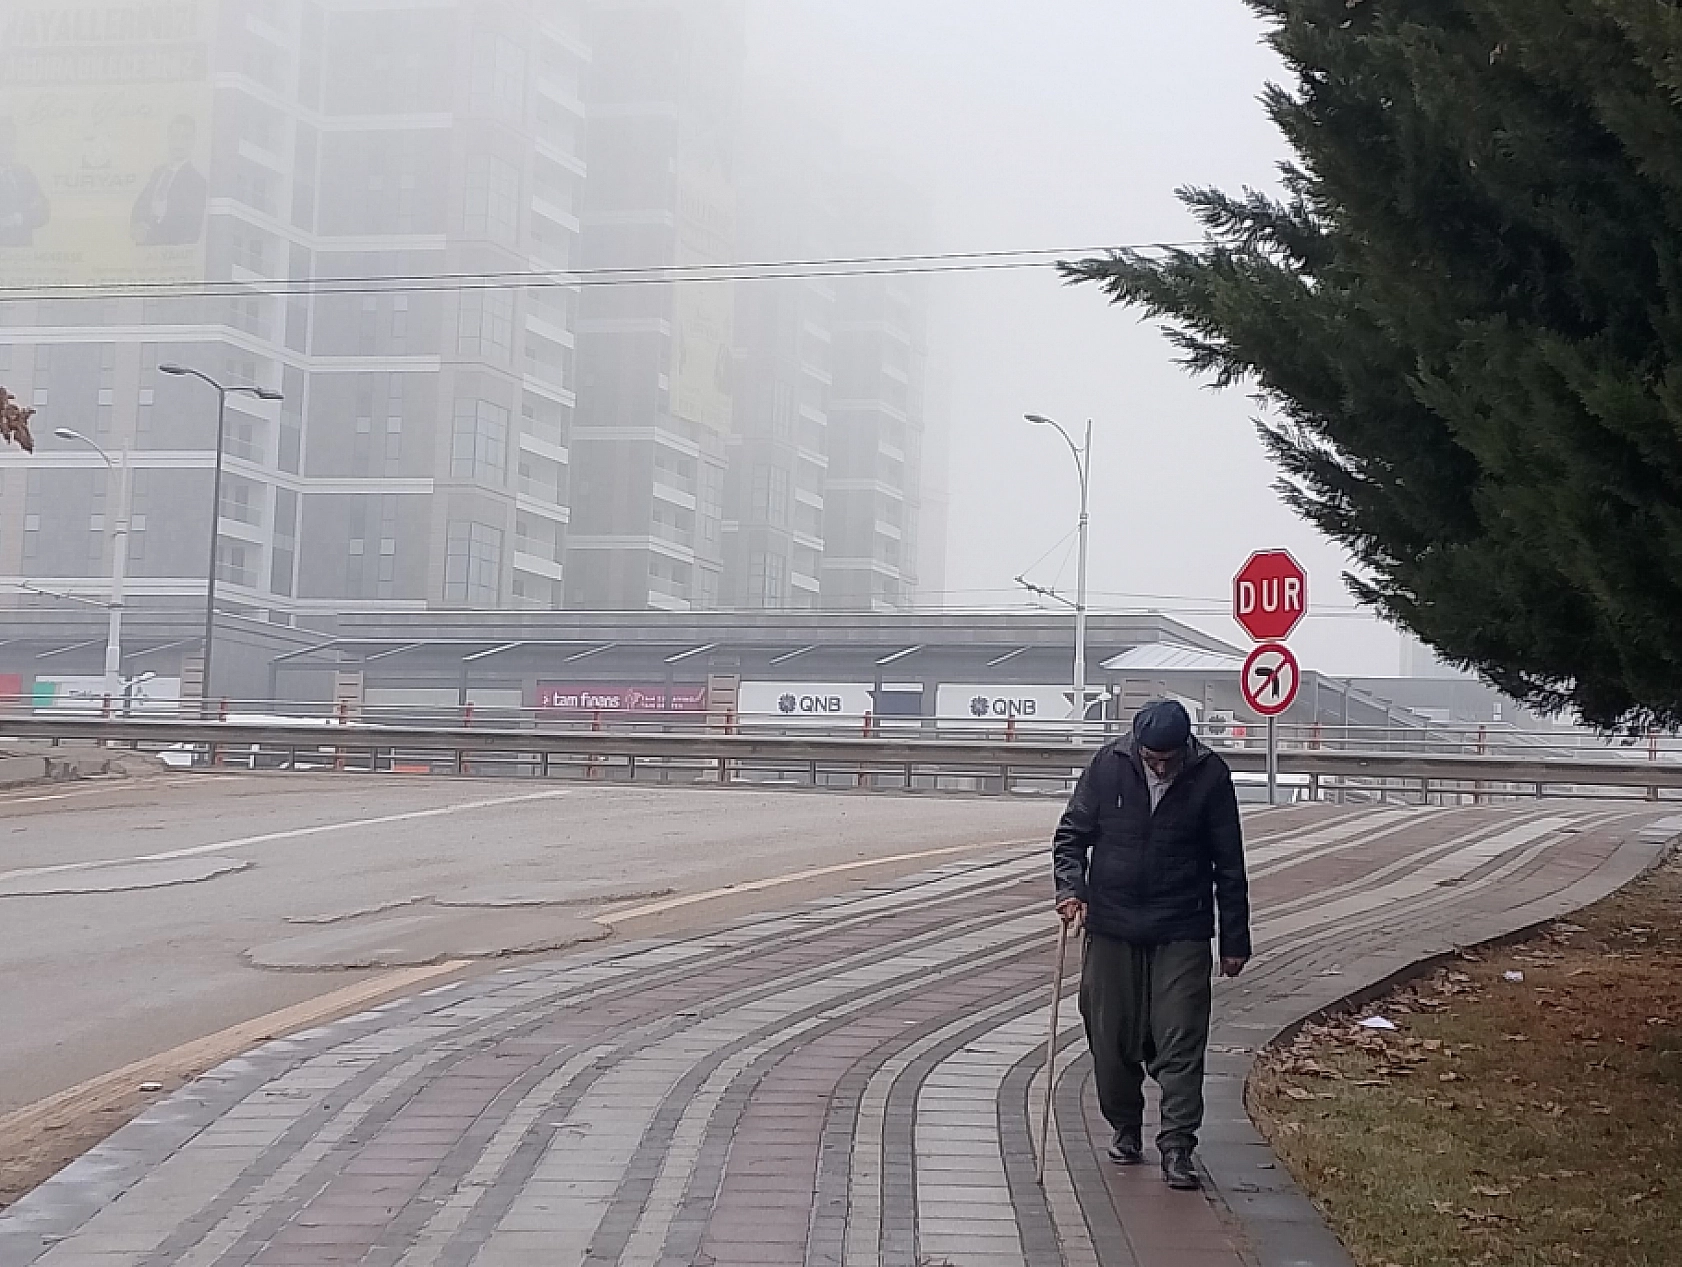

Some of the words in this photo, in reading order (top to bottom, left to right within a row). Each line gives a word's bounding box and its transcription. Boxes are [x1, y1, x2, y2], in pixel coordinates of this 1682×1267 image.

[1239, 577, 1301, 614] DUR
[552, 692, 578, 707] tam
[580, 692, 620, 708] finans
[800, 696, 841, 711] QNB
[993, 698, 1036, 715] QNB
